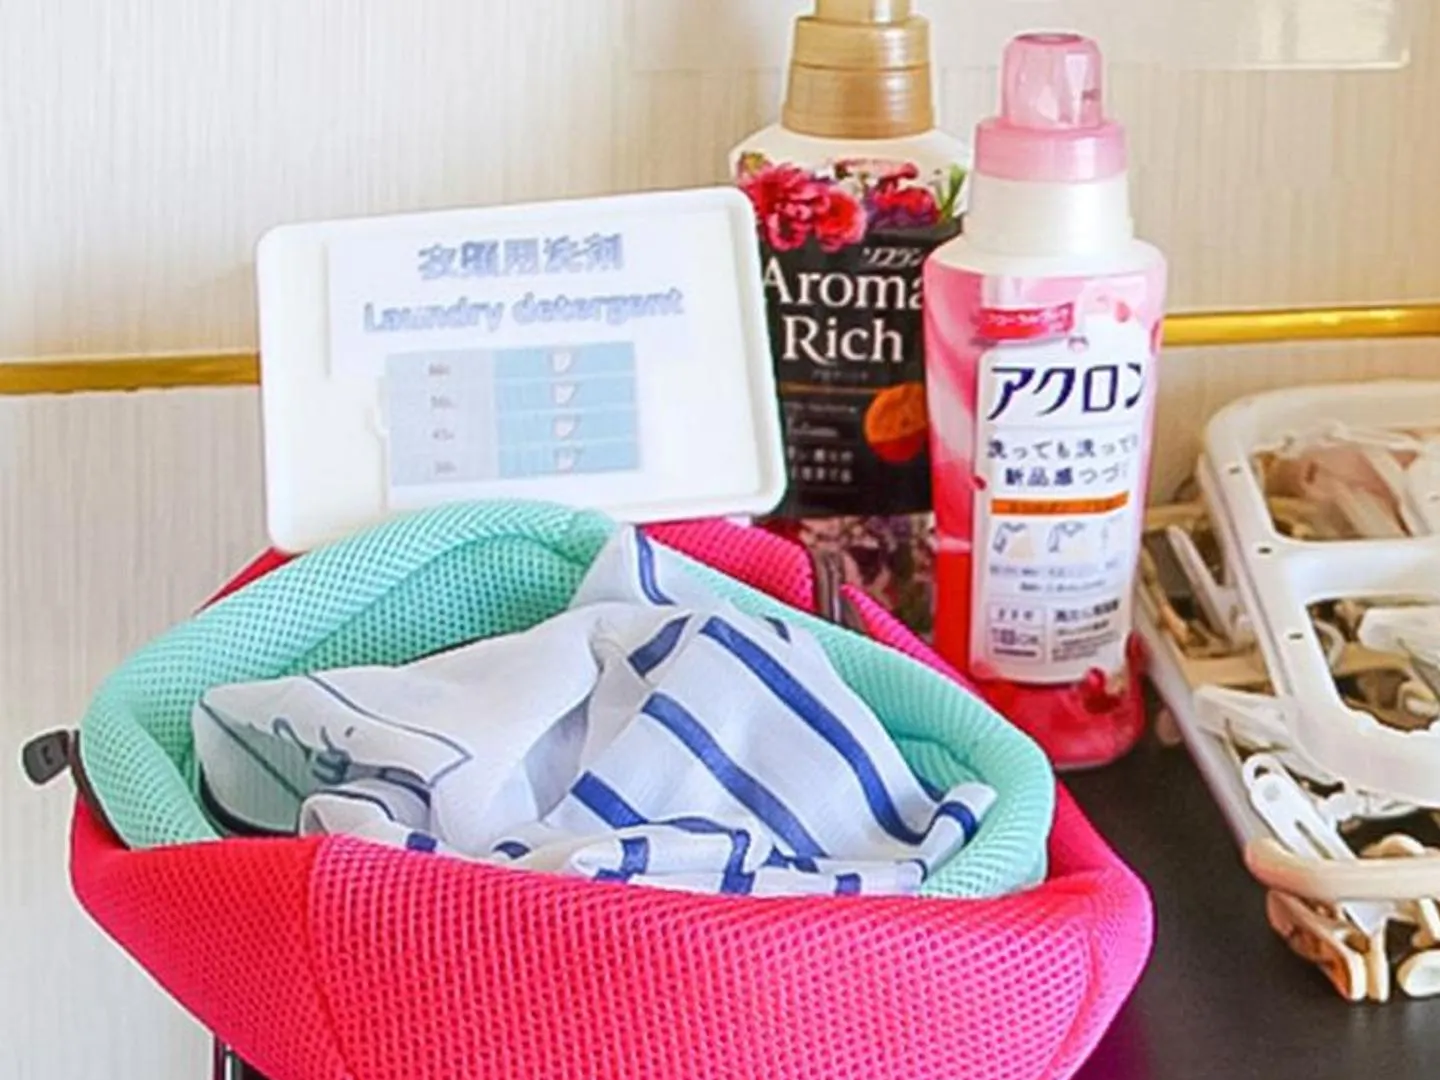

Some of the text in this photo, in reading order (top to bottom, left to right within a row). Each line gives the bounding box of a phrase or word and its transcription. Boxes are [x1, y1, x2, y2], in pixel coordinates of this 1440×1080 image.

[363, 296, 504, 333] Laundry
[782, 314, 903, 365] Rich
[986, 362, 1142, 421] アクロン
